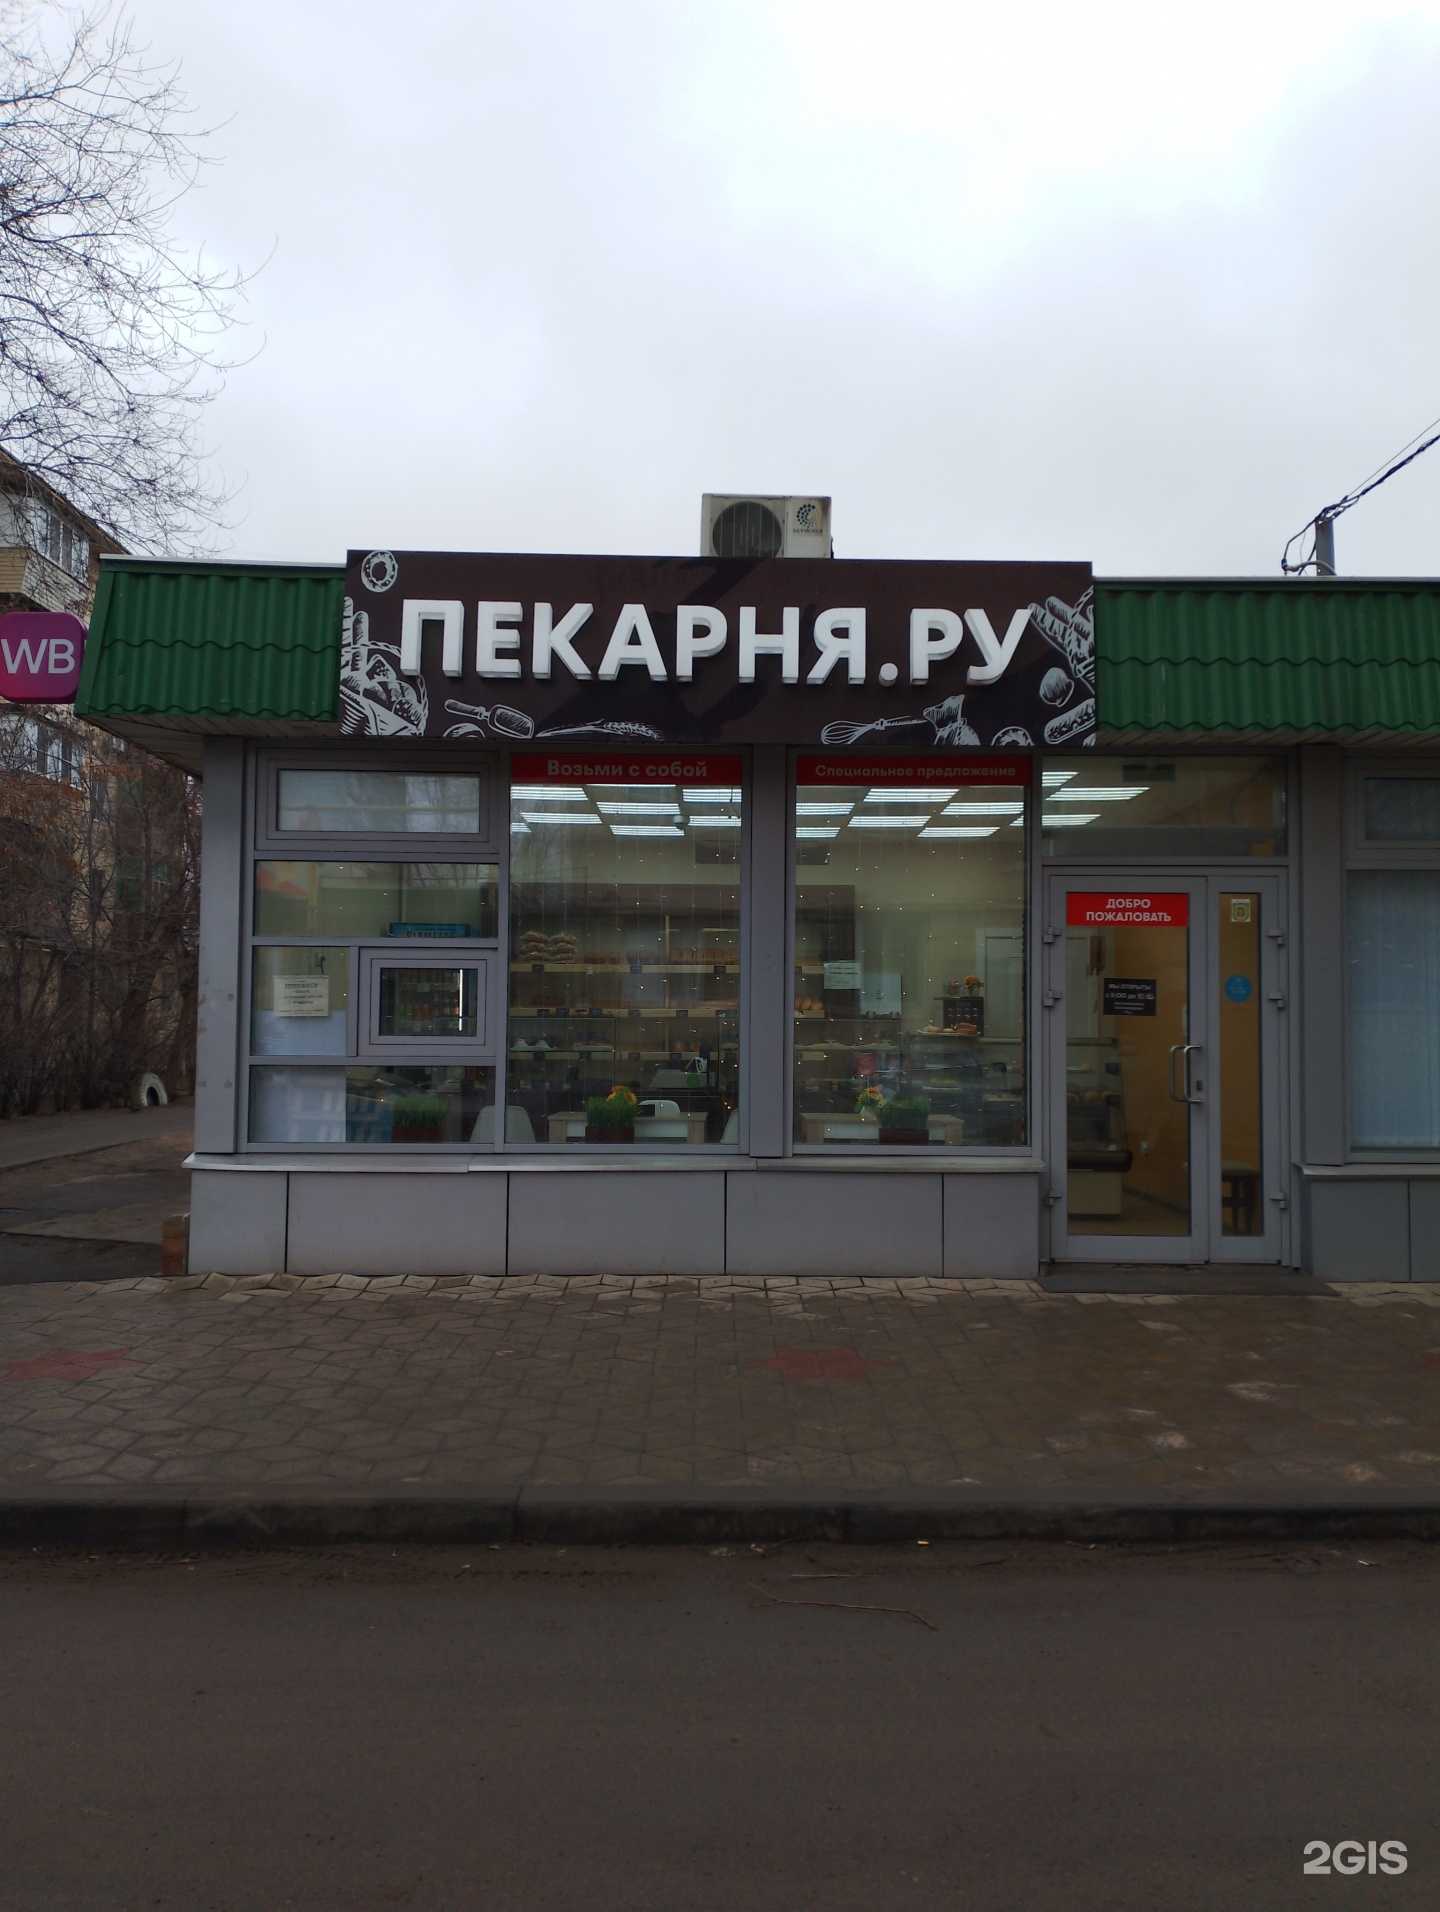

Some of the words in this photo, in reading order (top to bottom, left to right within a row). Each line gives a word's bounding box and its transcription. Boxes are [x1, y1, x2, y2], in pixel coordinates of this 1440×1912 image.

[402, 599, 1031, 686] ПЕКАРНЯ.РУ
[0, 638, 76, 674] WB
[547, 760, 622, 776] Возьми
[629, 765, 641, 777] с
[645, 761, 707, 777] собой
[815, 765, 912, 777] Специальное
[917, 767, 1016, 779] предложение
[1105, 898, 1151, 909] ДОБРО
[1086, 912, 1172, 922] ПОЖАЛОВАТЬ
